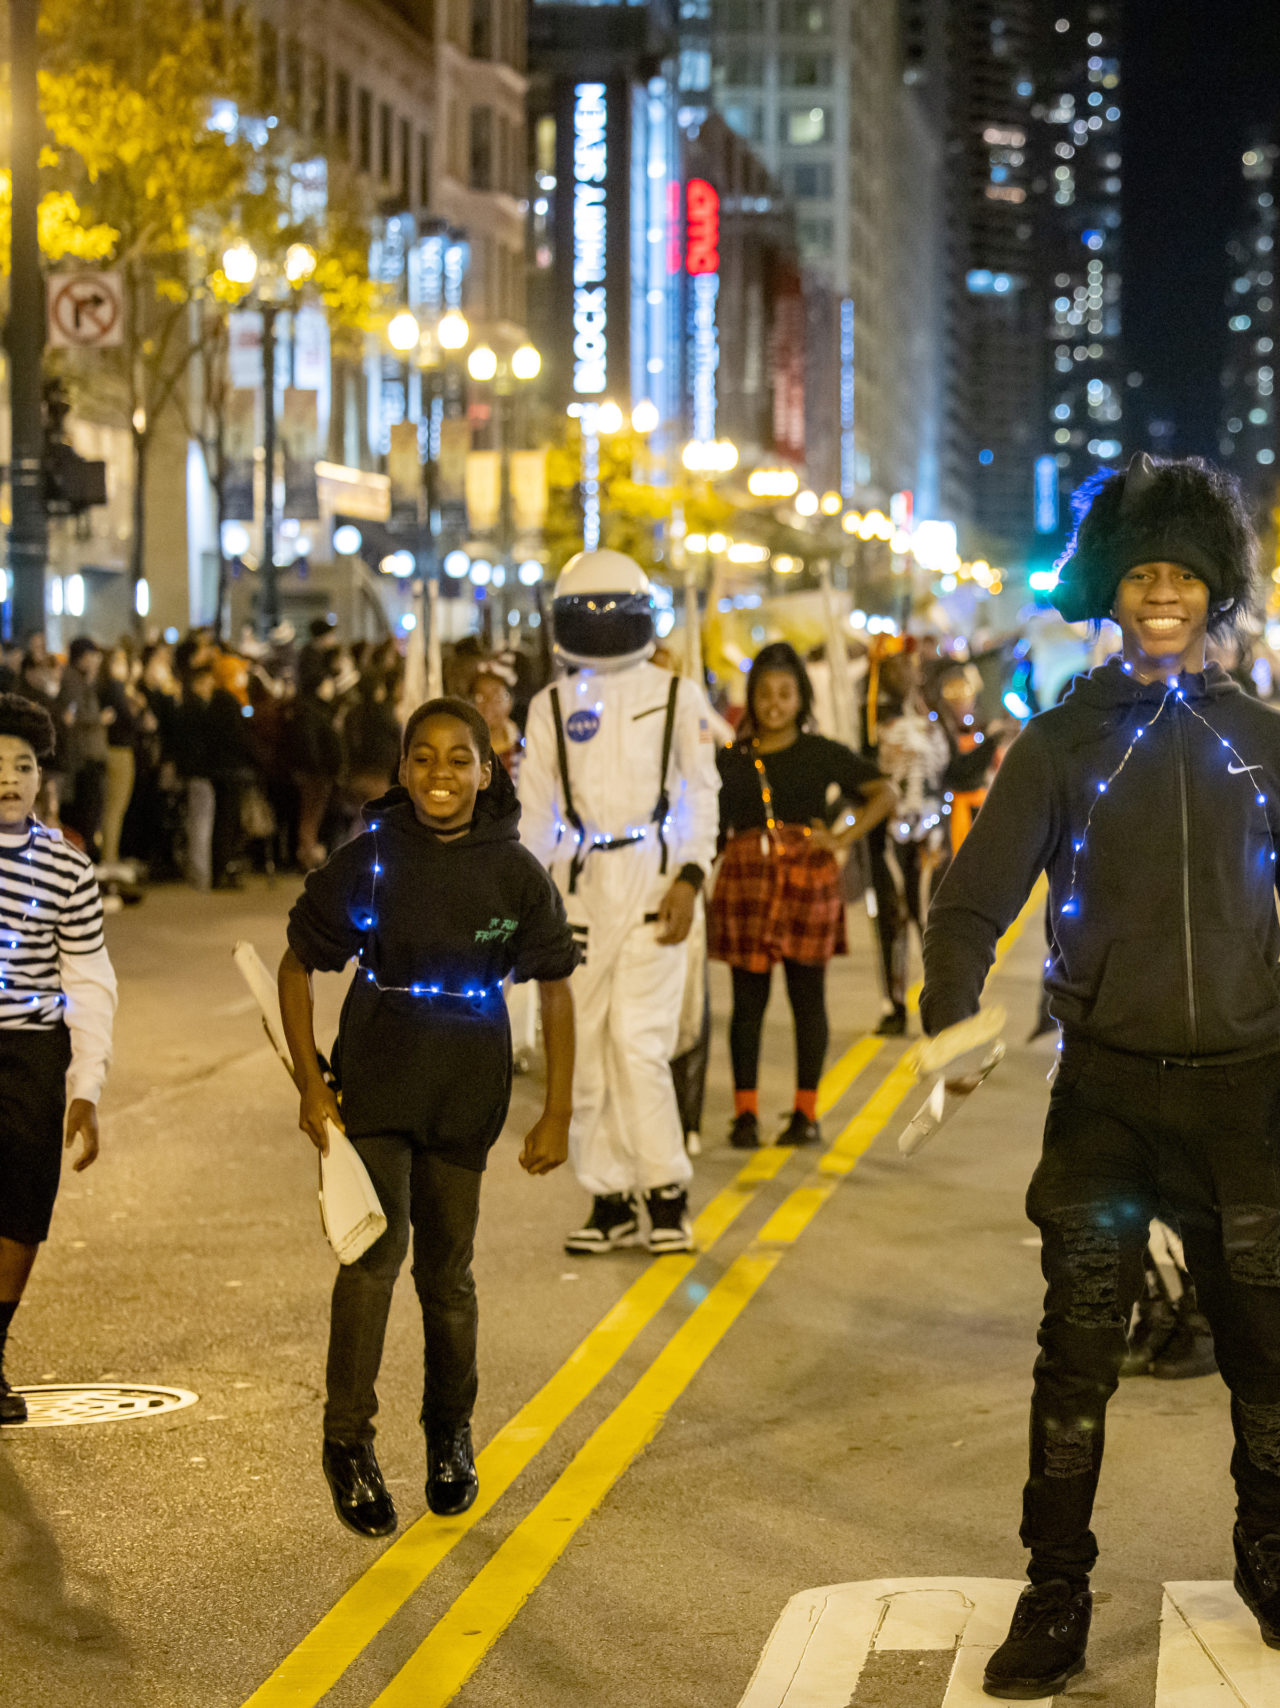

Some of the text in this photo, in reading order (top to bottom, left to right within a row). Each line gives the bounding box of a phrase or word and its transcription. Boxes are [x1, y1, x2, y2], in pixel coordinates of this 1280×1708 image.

[573, 83, 607, 181] SEVEN
[573, 183, 607, 287] THIRTY
[573, 288, 607, 394] BLOCK
